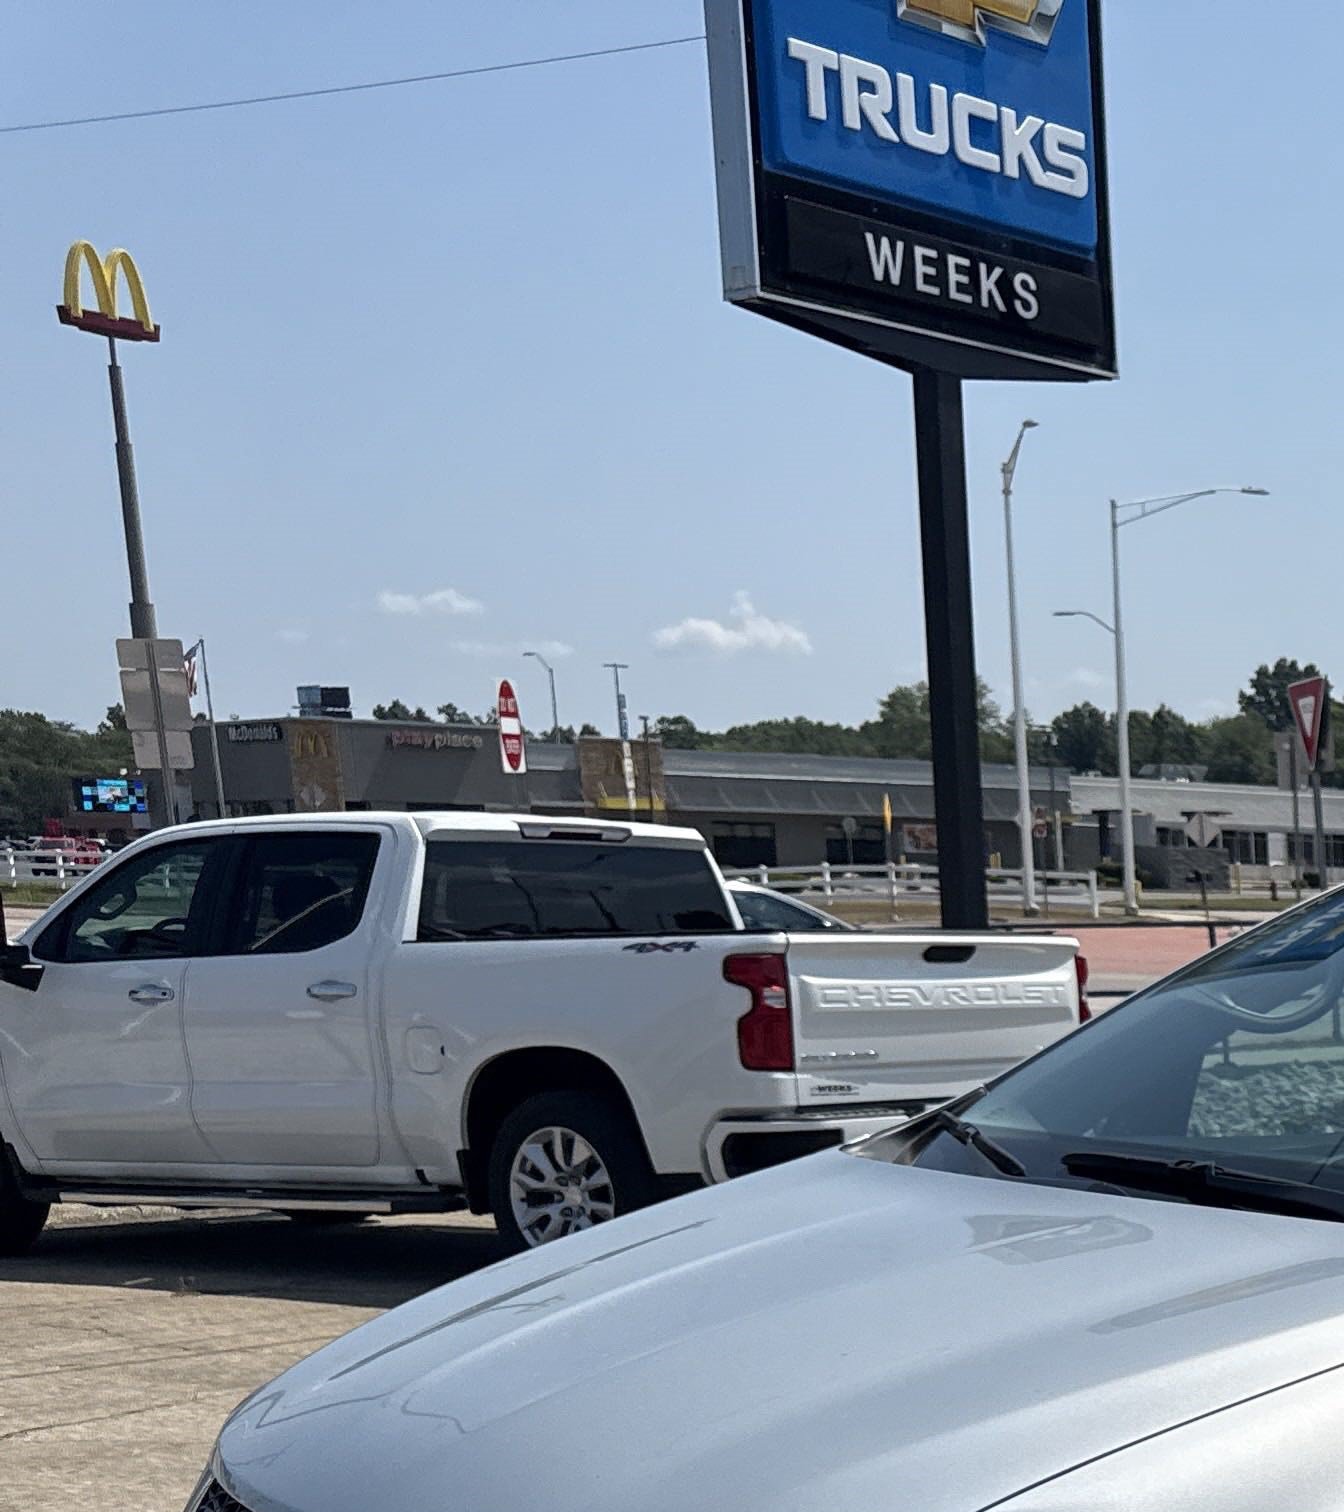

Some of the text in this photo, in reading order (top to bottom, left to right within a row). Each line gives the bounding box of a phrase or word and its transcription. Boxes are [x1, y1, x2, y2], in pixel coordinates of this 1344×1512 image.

[787, 36, 1089, 199] TRUCKS
[864, 231, 1040, 320] WEEKS
[816, 985, 1065, 1009] CHEVROLET
[817, 1084, 852, 1093] WEEKS
